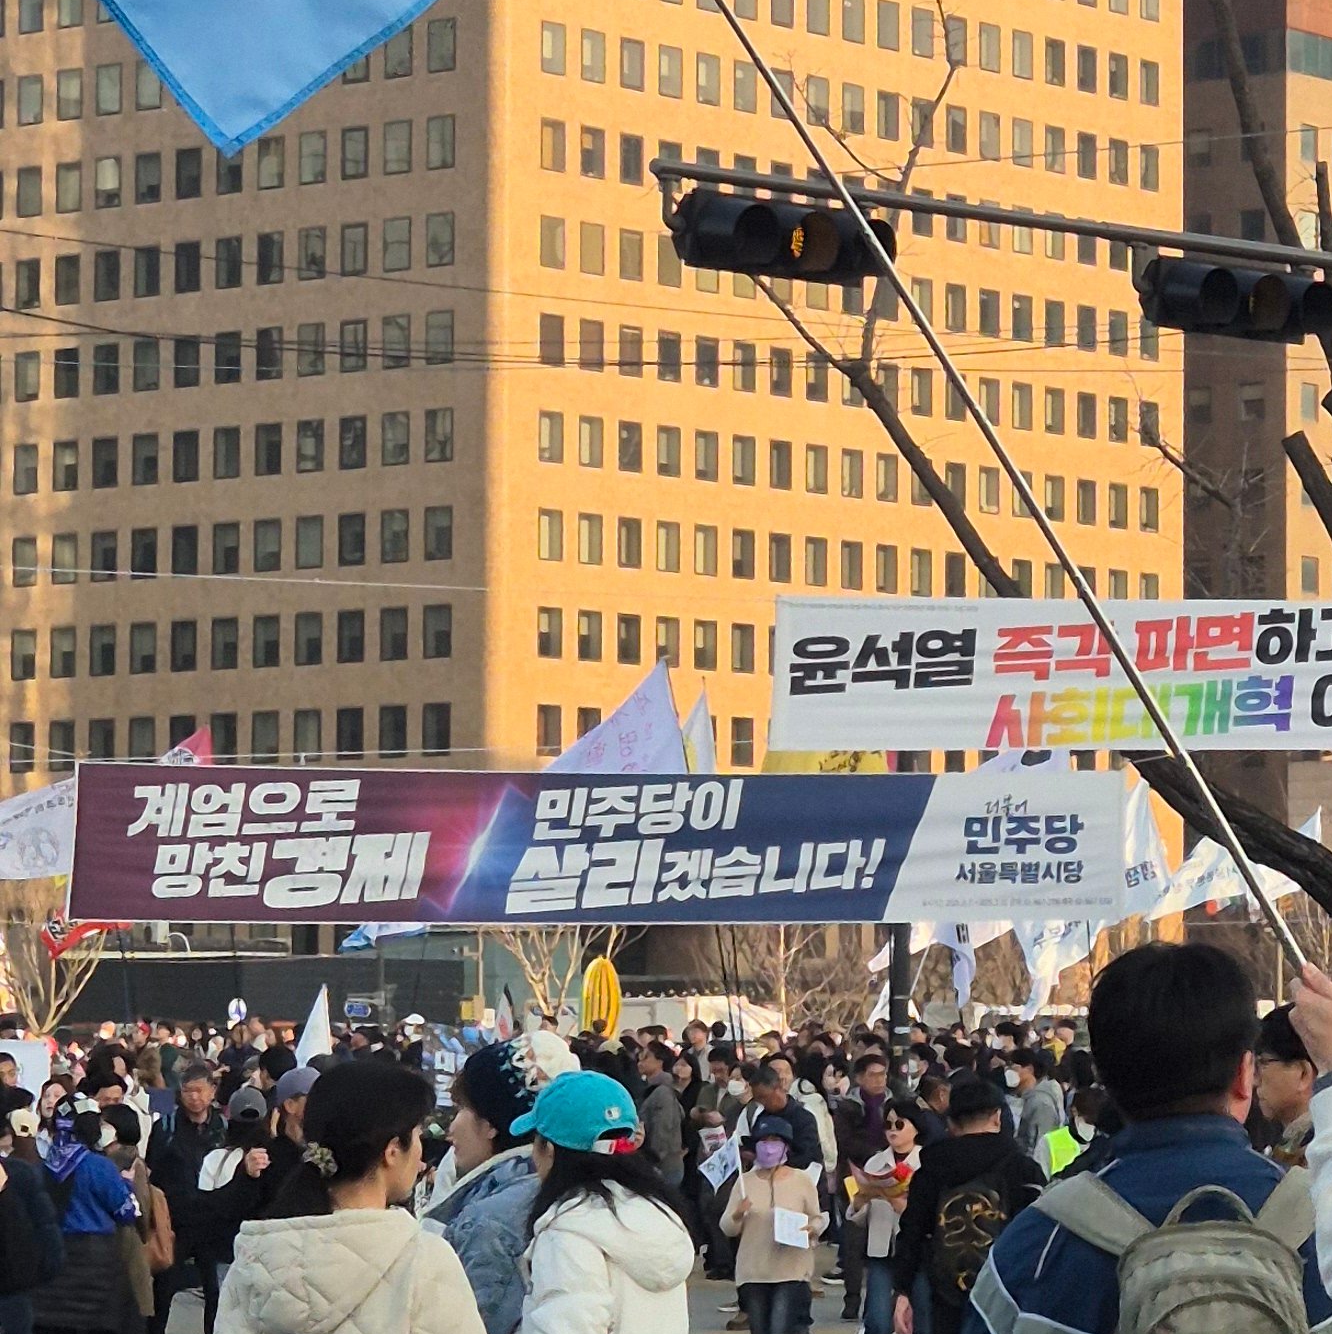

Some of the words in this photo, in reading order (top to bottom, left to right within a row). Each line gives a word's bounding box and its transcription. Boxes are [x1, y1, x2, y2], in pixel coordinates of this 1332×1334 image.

[788, 628, 976, 696] 윤석열
[990, 622, 1114, 680] 즉각
[127, 779, 361, 838] 계엄으로
[535, 778, 742, 841] 민주당이
[963, 813, 1084, 855] 민주당
[152, 841, 267, 899] 망친
[263, 832, 431, 909] 경제
[506, 839, 884, 914] 살리겠습니다!
[956, 859, 1084, 885] 서울특별시당
